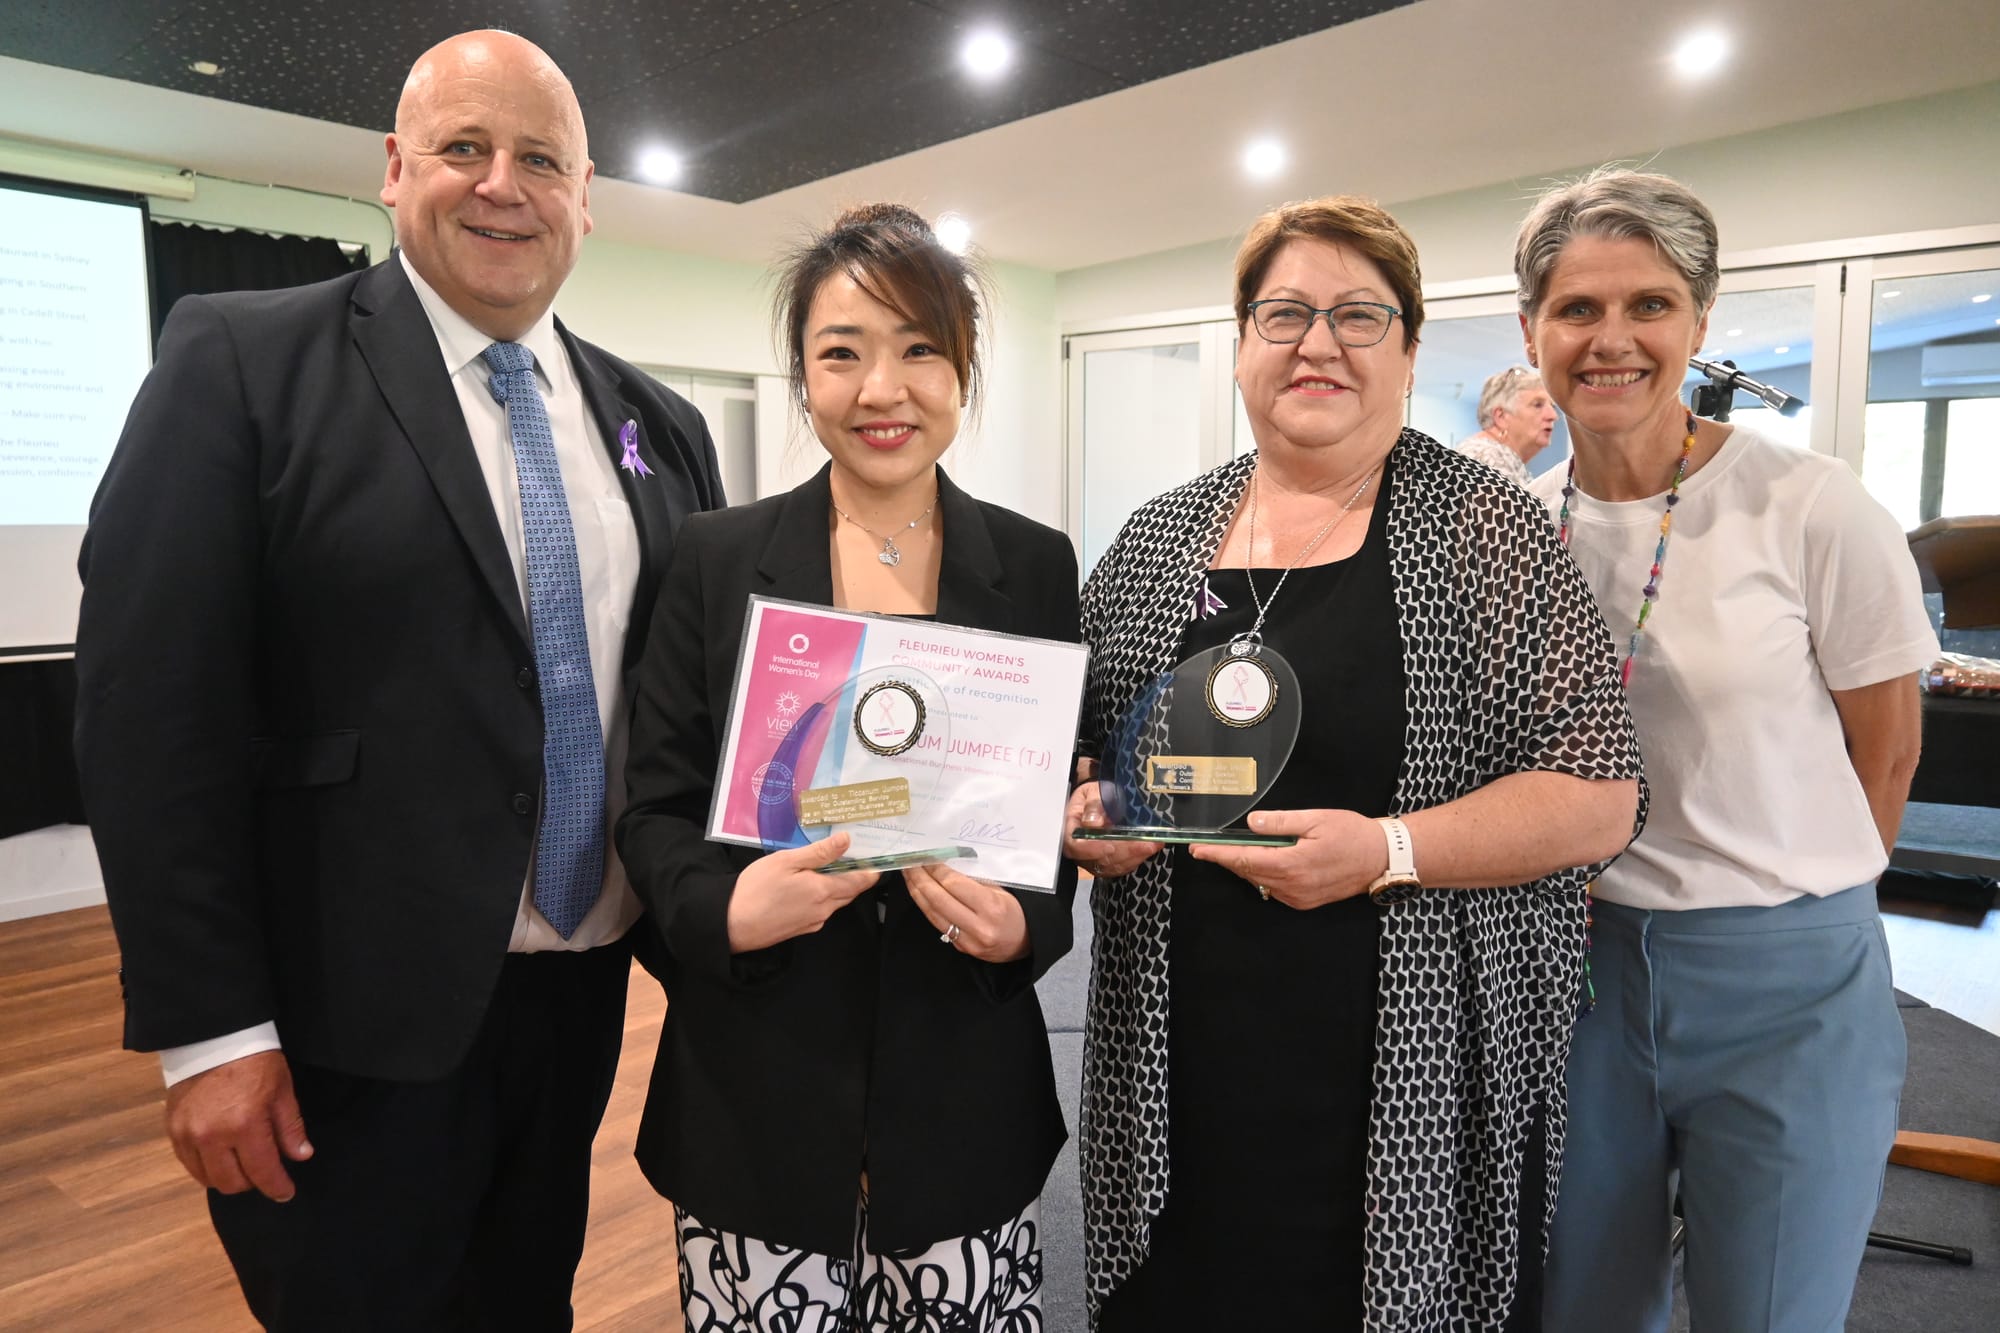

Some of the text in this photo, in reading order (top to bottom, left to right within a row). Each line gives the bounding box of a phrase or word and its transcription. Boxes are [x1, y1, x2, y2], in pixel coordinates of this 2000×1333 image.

[54, 252, 90, 266] Sydney
[40, 280, 87, 294] Southern
[21, 307, 54, 319] Cadell
[8, 336, 32, 345] with
[31, 368, 66, 377] events
[16, 381, 83, 393] environment
[85, 385, 104, 394] and
[11, 409, 87, 423] Make sure you
[17, 438, 60, 449] Fleurieu
[898, 639, 1025, 668] FLEURIEU WOMEN'S
[772, 655, 820, 669] International
[768, 663, 821, 680] Women's Day
[973, 667, 1031, 685] AWARDS
[953, 686, 966, 696] of
[968, 688, 1039, 705] recognition
[947, 738, 1014, 763] JUMPEE
[1018, 746, 1052, 771] (TJ)
